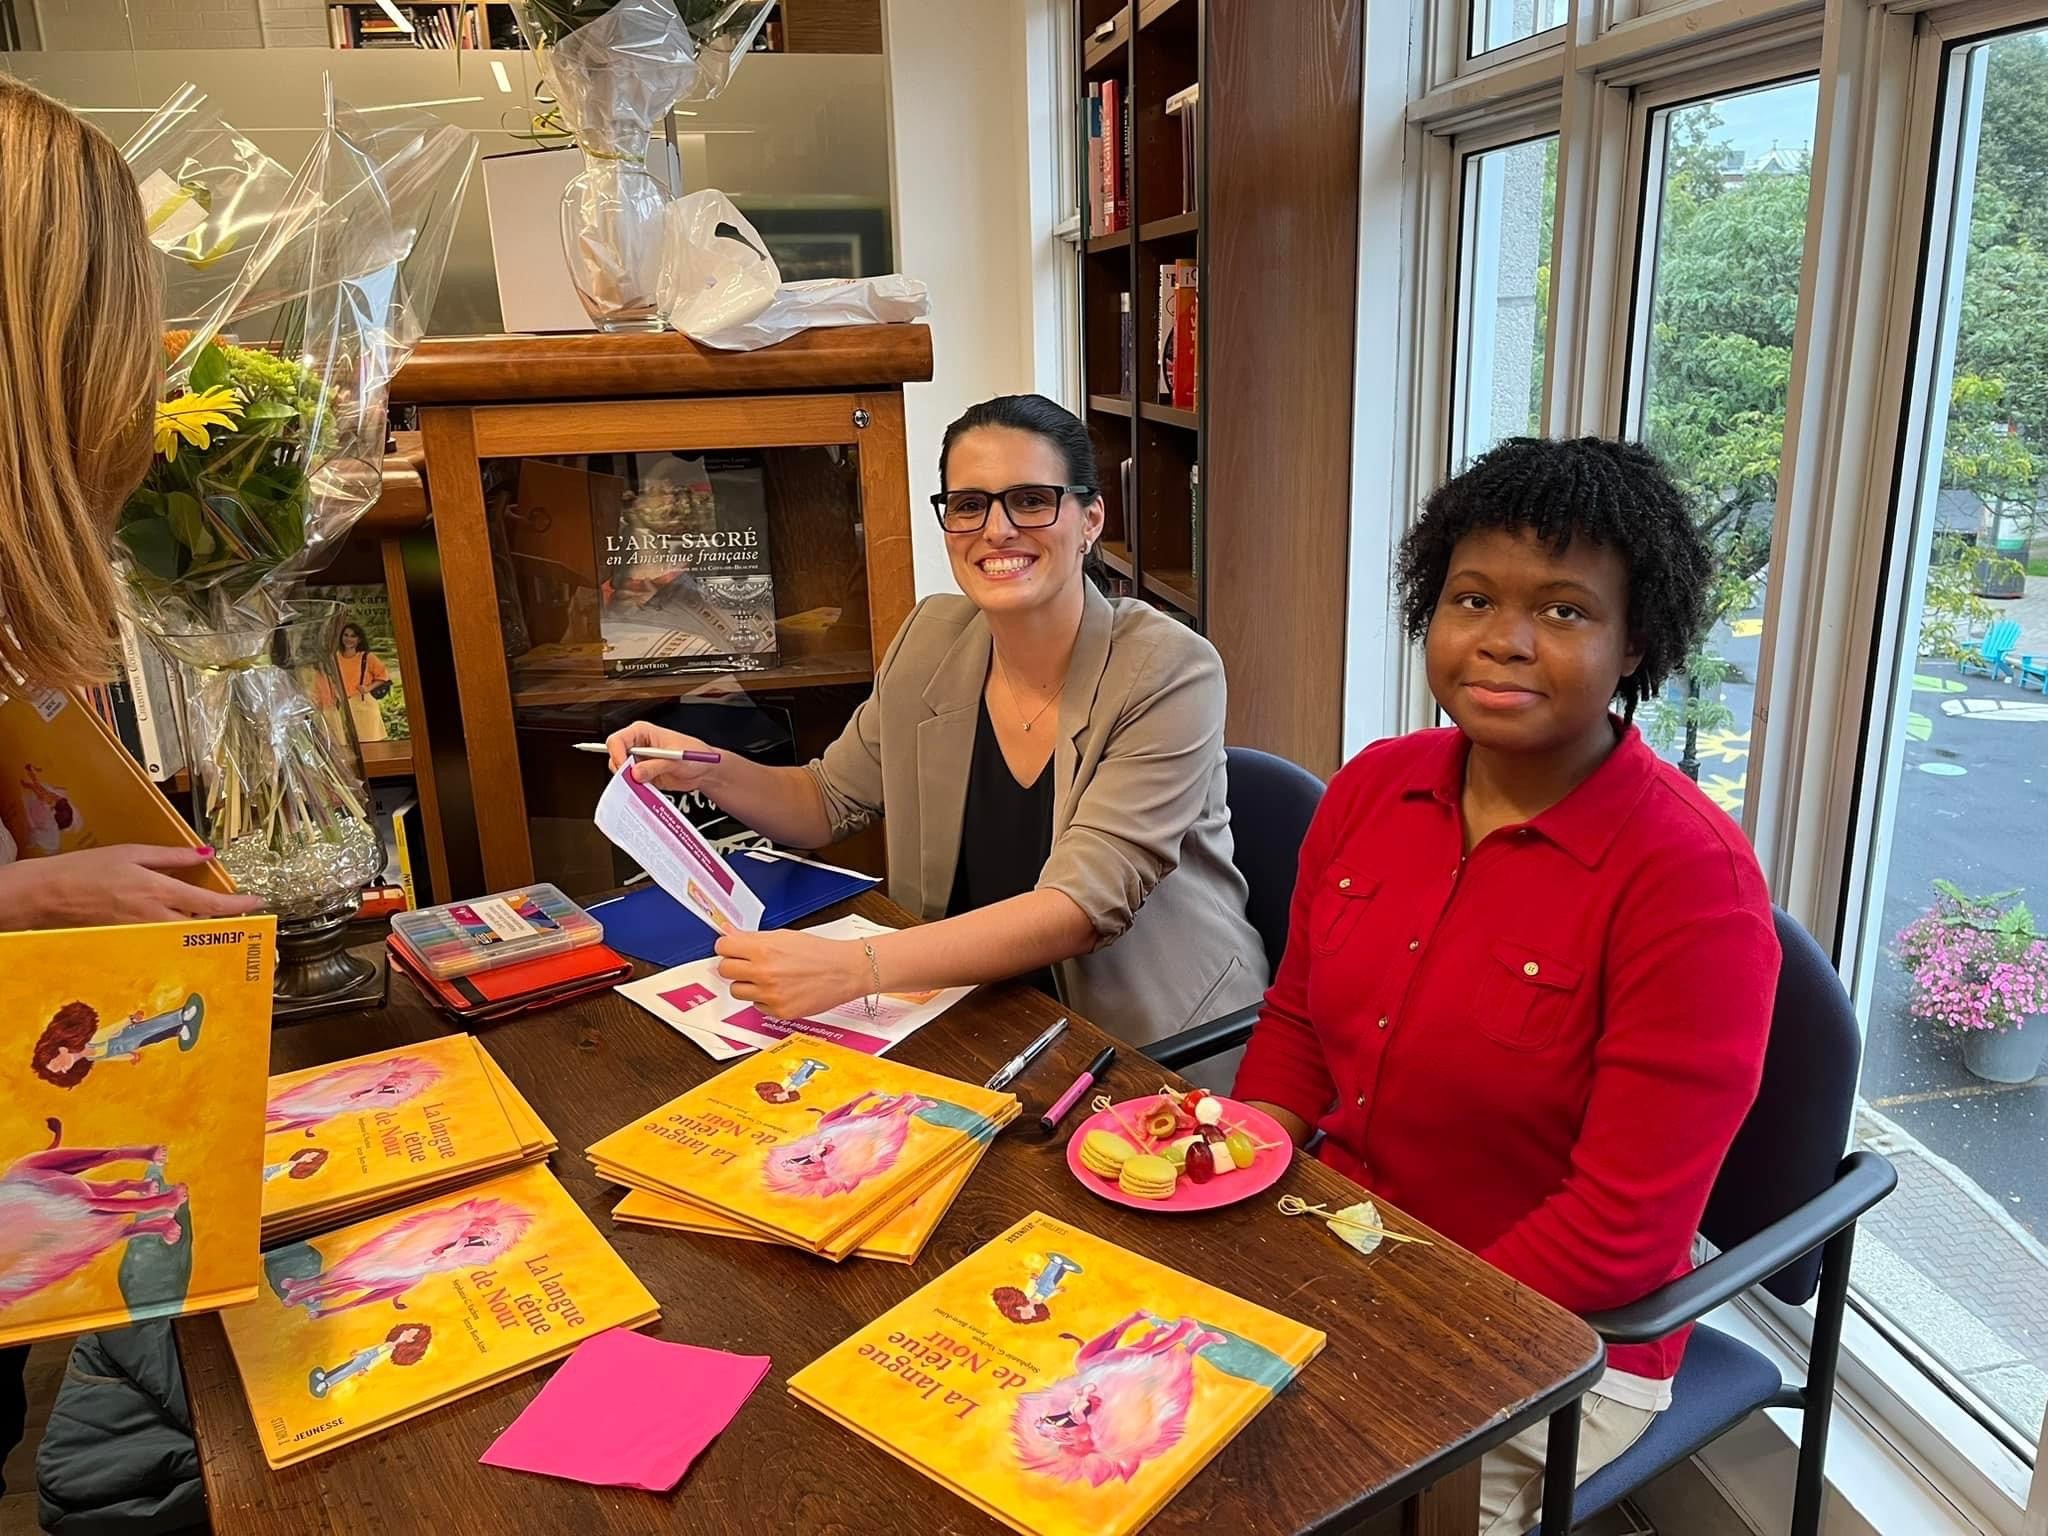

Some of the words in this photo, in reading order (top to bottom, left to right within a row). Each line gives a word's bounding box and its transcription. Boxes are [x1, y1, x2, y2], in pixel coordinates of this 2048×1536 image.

[606, 534, 671, 551] L'ART
[681, 526, 758, 548] SACRÉ
[606, 556, 621, 566] en
[626, 551, 693, 565] Amérique
[696, 547, 759, 564] française
[624, 663, 670, 671] SEPTENTRION
[183, 931, 245, 948] JEUNESSE
[246, 943, 262, 981] STATION
[374, 1112, 398, 1126] de
[423, 1102, 444, 1119] La
[668, 1114, 719, 1137] têtue
[697, 1112, 752, 1137] Nour
[378, 1125, 403, 1158] Nour
[403, 1131, 427, 1163] têtue
[427, 1117, 456, 1159] langue
[643, 1122, 711, 1155] langue
[751, 1130, 778, 1145] de
[710, 1148, 737, 1165] La
[470, 1270, 498, 1290] de
[525, 1254, 549, 1276] La
[538, 1272, 585, 1328] langue
[481, 1286, 521, 1330] Nour
[513, 1293, 552, 1335] têtue
[888, 1331, 952, 1371] têtue
[923, 1331, 992, 1374] Nour
[858, 1343, 944, 1400] langue
[992, 1366, 1027, 1390] de
[943, 1389, 980, 1420] La
[293, 1417, 345, 1441] JEUNESSE
